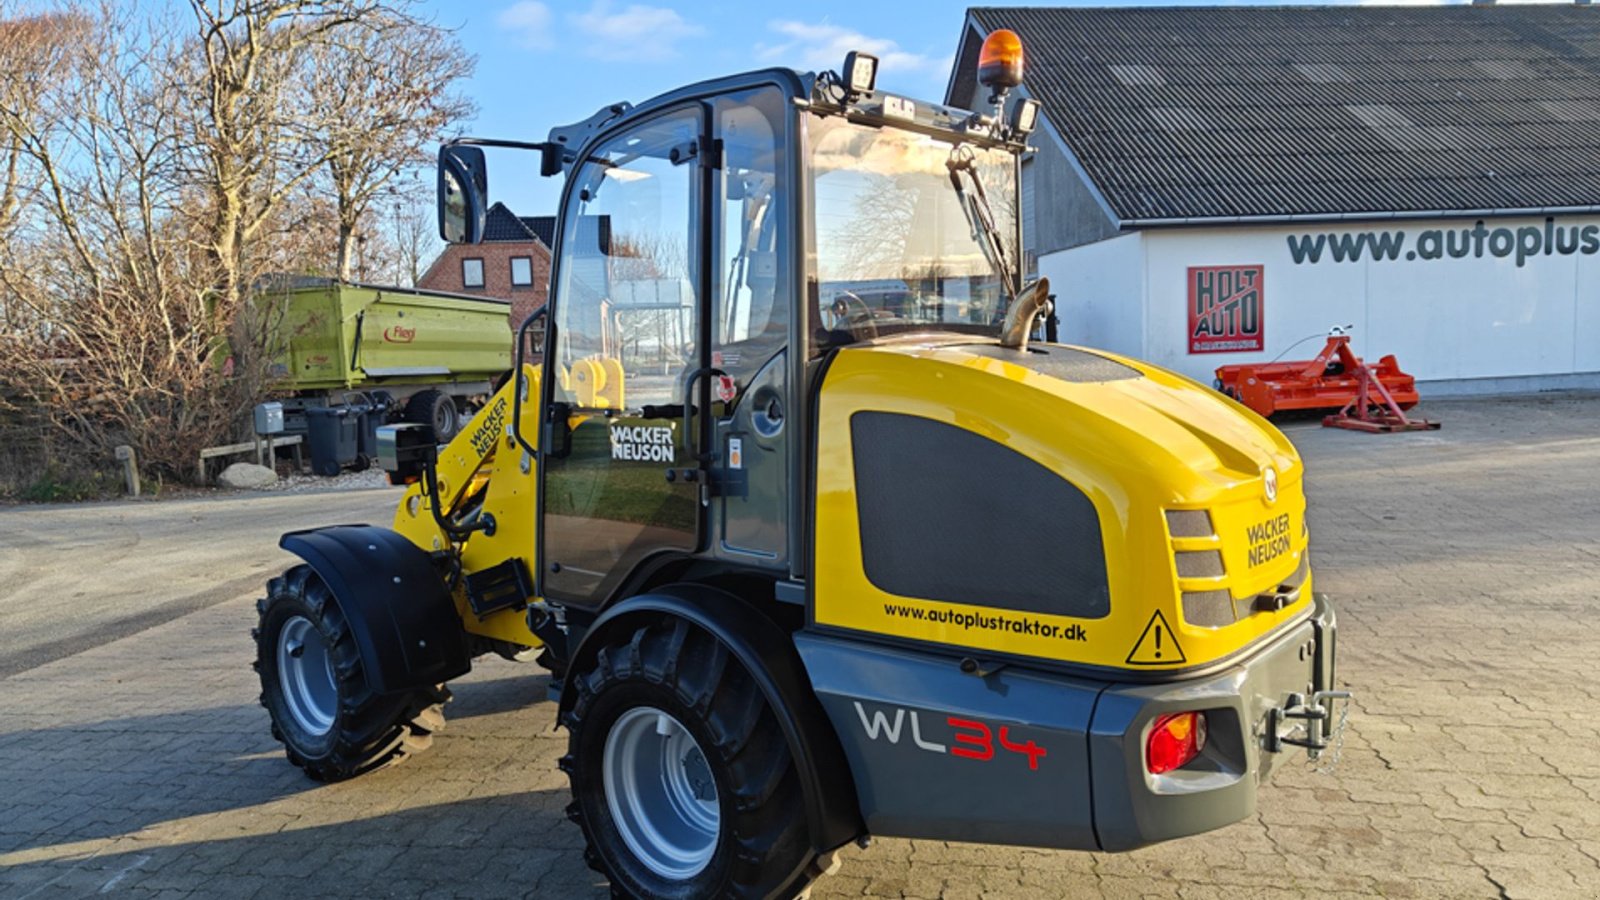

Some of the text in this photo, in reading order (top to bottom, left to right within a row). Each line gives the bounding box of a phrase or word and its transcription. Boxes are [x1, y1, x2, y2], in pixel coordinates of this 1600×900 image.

[1287, 217, 1599, 267] www.autoplus
[1194, 290, 1258, 337] AUTO
[1196, 270, 1258, 315] HOLT
[470, 397, 507, 446] WACKER
[476, 415, 504, 458] NEUS
[611, 426, 673, 444] WACKER
[612, 443, 675, 462] NEUSON
[1246, 513, 1290, 546] WACKER
[1248, 532, 1291, 569] NEUSON
[884, 604, 1087, 642] www.autoplustraktor.dk
[854, 701, 1047, 770] WL34
